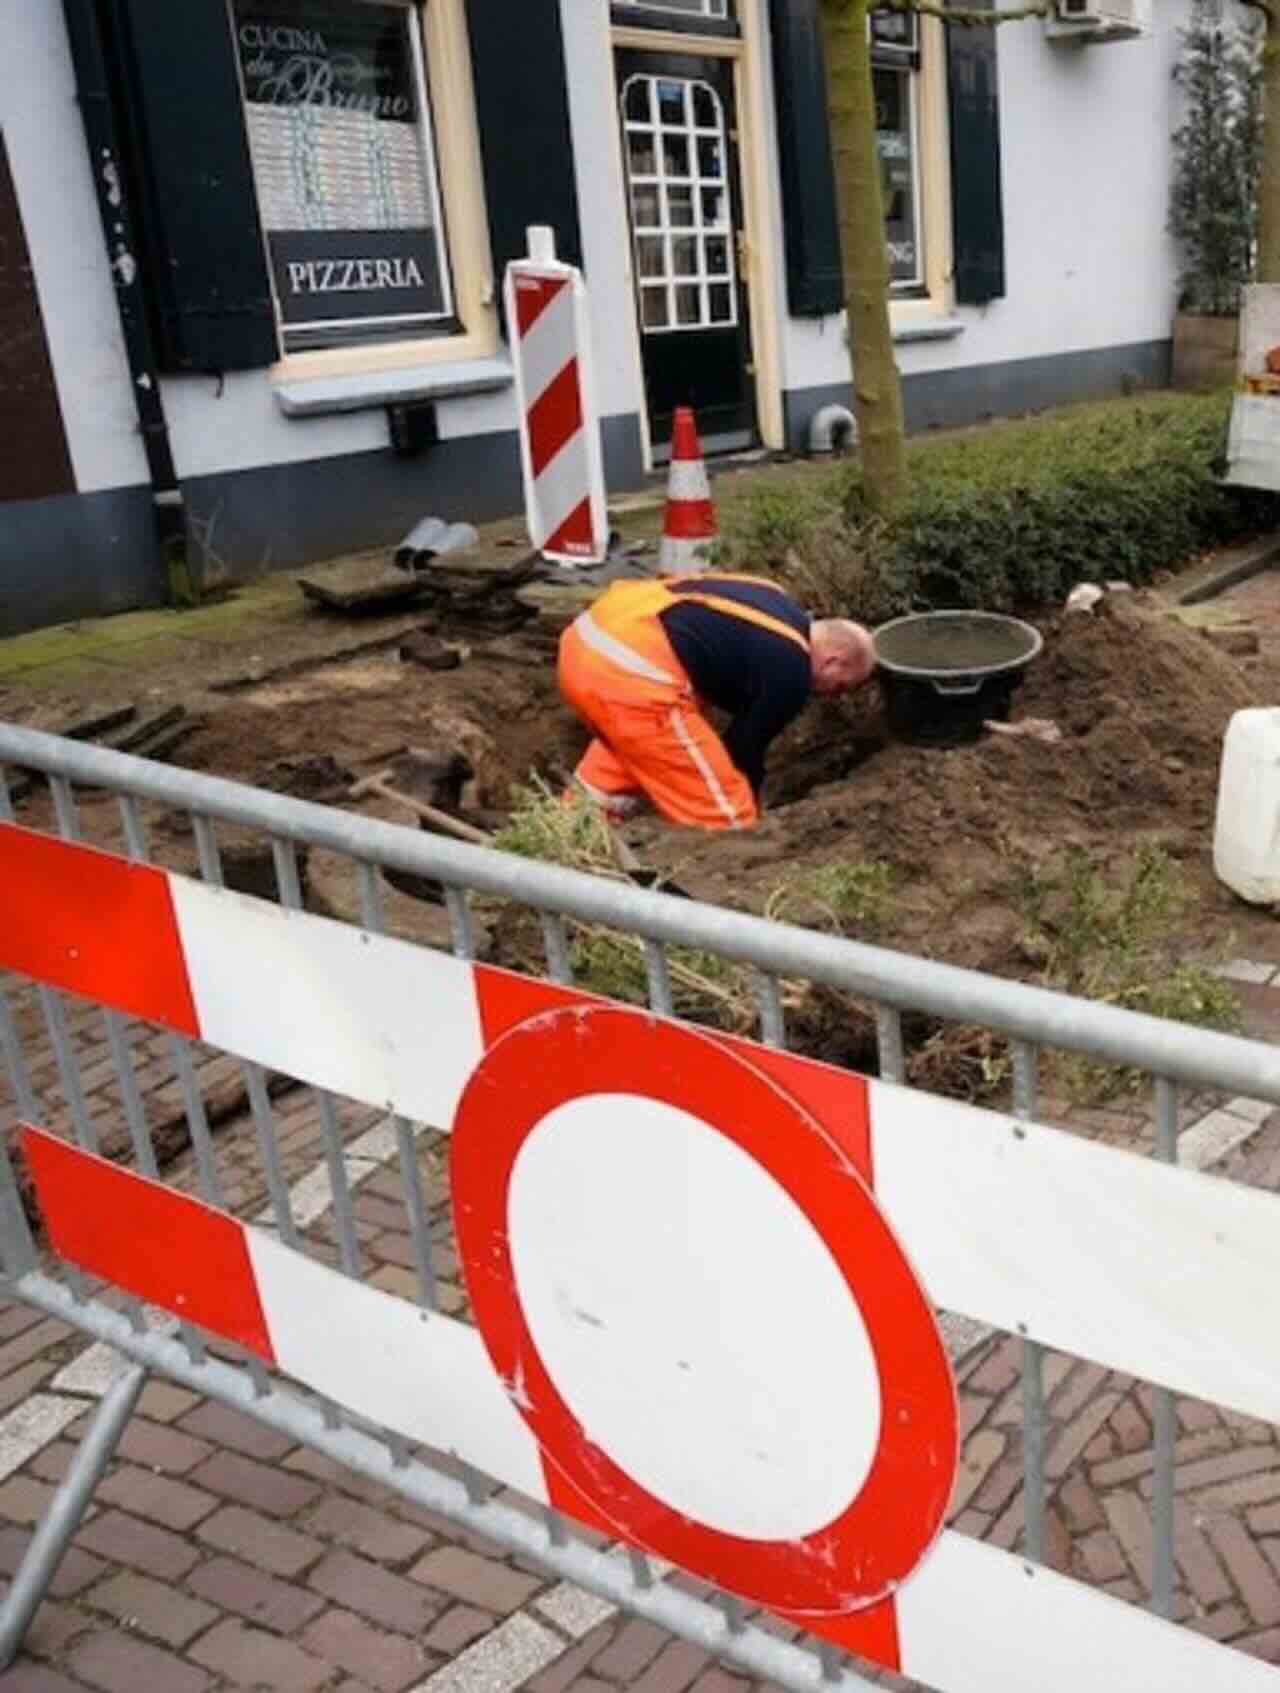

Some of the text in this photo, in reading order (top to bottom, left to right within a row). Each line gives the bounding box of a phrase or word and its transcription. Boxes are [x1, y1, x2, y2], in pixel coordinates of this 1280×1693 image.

[240, 25, 328, 52] CUCINA
[262, 54, 409, 116] Bruno
[288, 258, 424, 293] PIZZERIA
